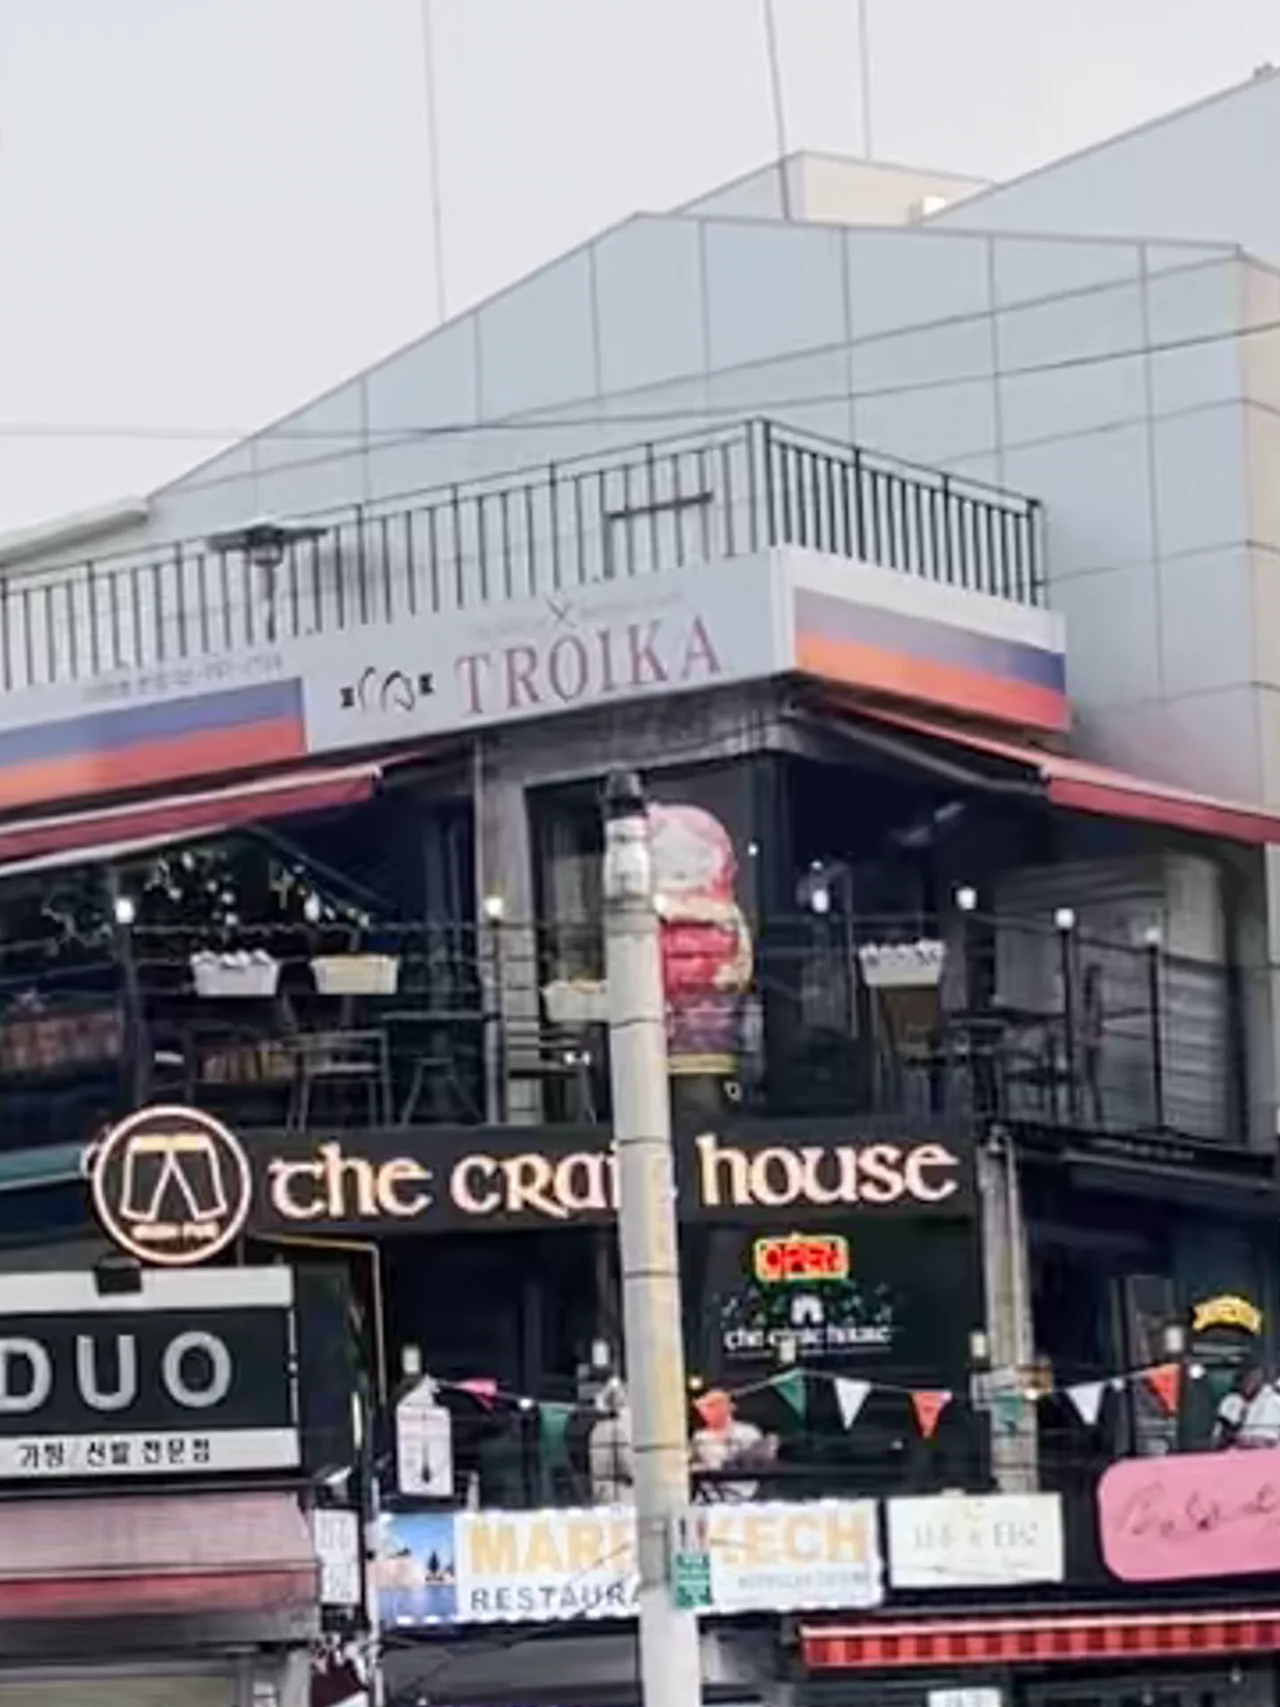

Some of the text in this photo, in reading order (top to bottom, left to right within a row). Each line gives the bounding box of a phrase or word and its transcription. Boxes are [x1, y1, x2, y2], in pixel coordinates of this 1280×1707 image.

[455, 615, 722, 716] TROIKA
[268, 1141, 433, 1219] the
[695, 1131, 960, 1206] house
